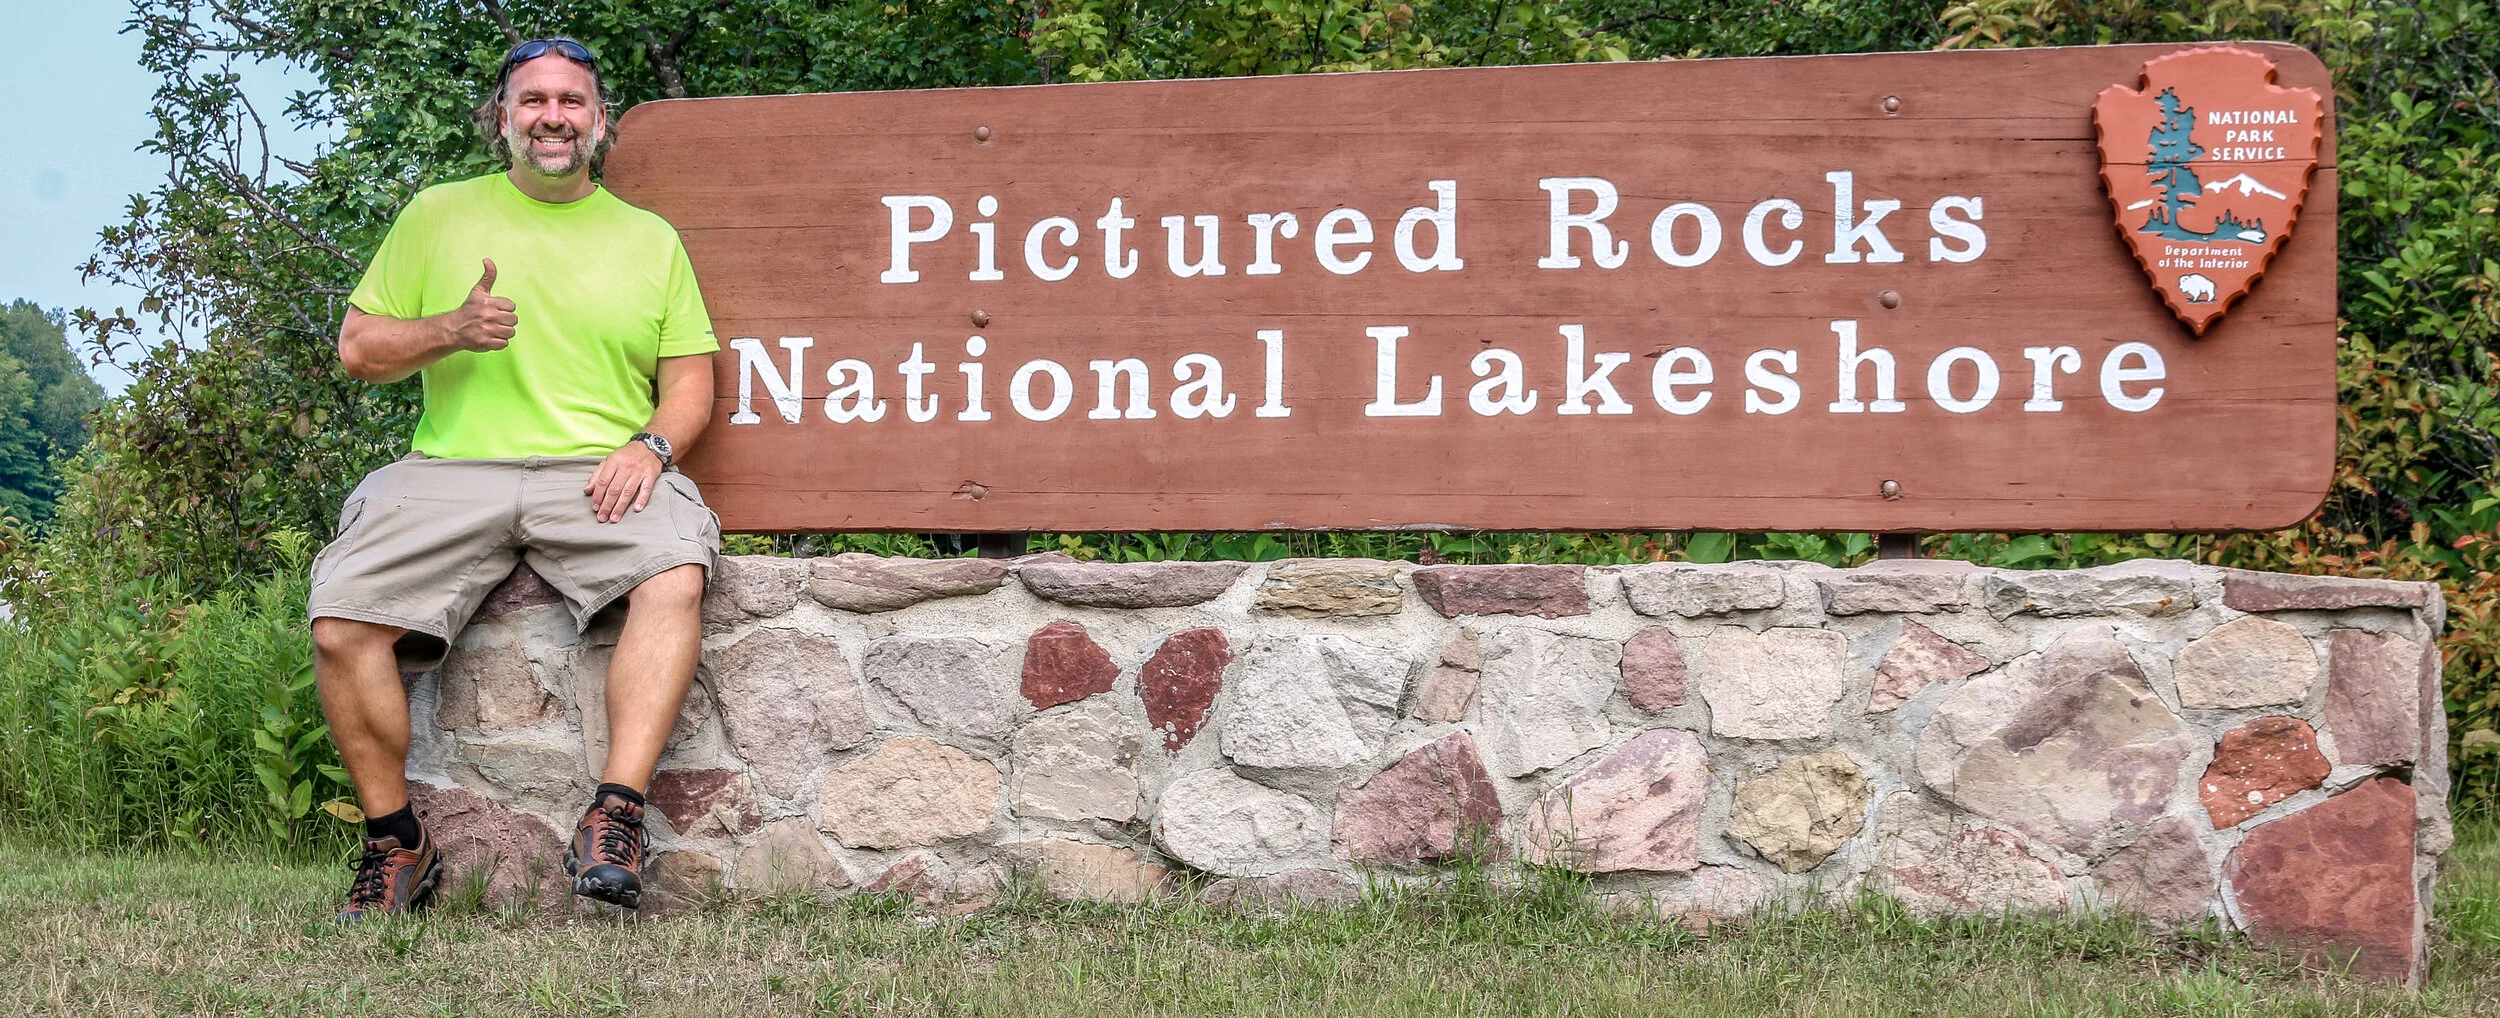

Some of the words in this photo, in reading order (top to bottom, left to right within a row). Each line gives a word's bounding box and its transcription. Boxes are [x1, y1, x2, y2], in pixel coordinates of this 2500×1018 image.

[2208, 110, 2297, 125] NATIONAL
[2226, 129, 2274, 143] PARK
[2212, 147, 2285, 160] SERVICE
[880, 179, 1464, 284] Pictured
[1538, 170, 1988, 270] Rocks
[2165, 245, 2242, 257] Department
[2158, 257, 2170, 268] of
[2174, 257, 2194, 268] the
[2199, 258, 2248, 269] Interior
[728, 328, 1292, 425] National
[1363, 320, 2167, 418] Lakeshore
